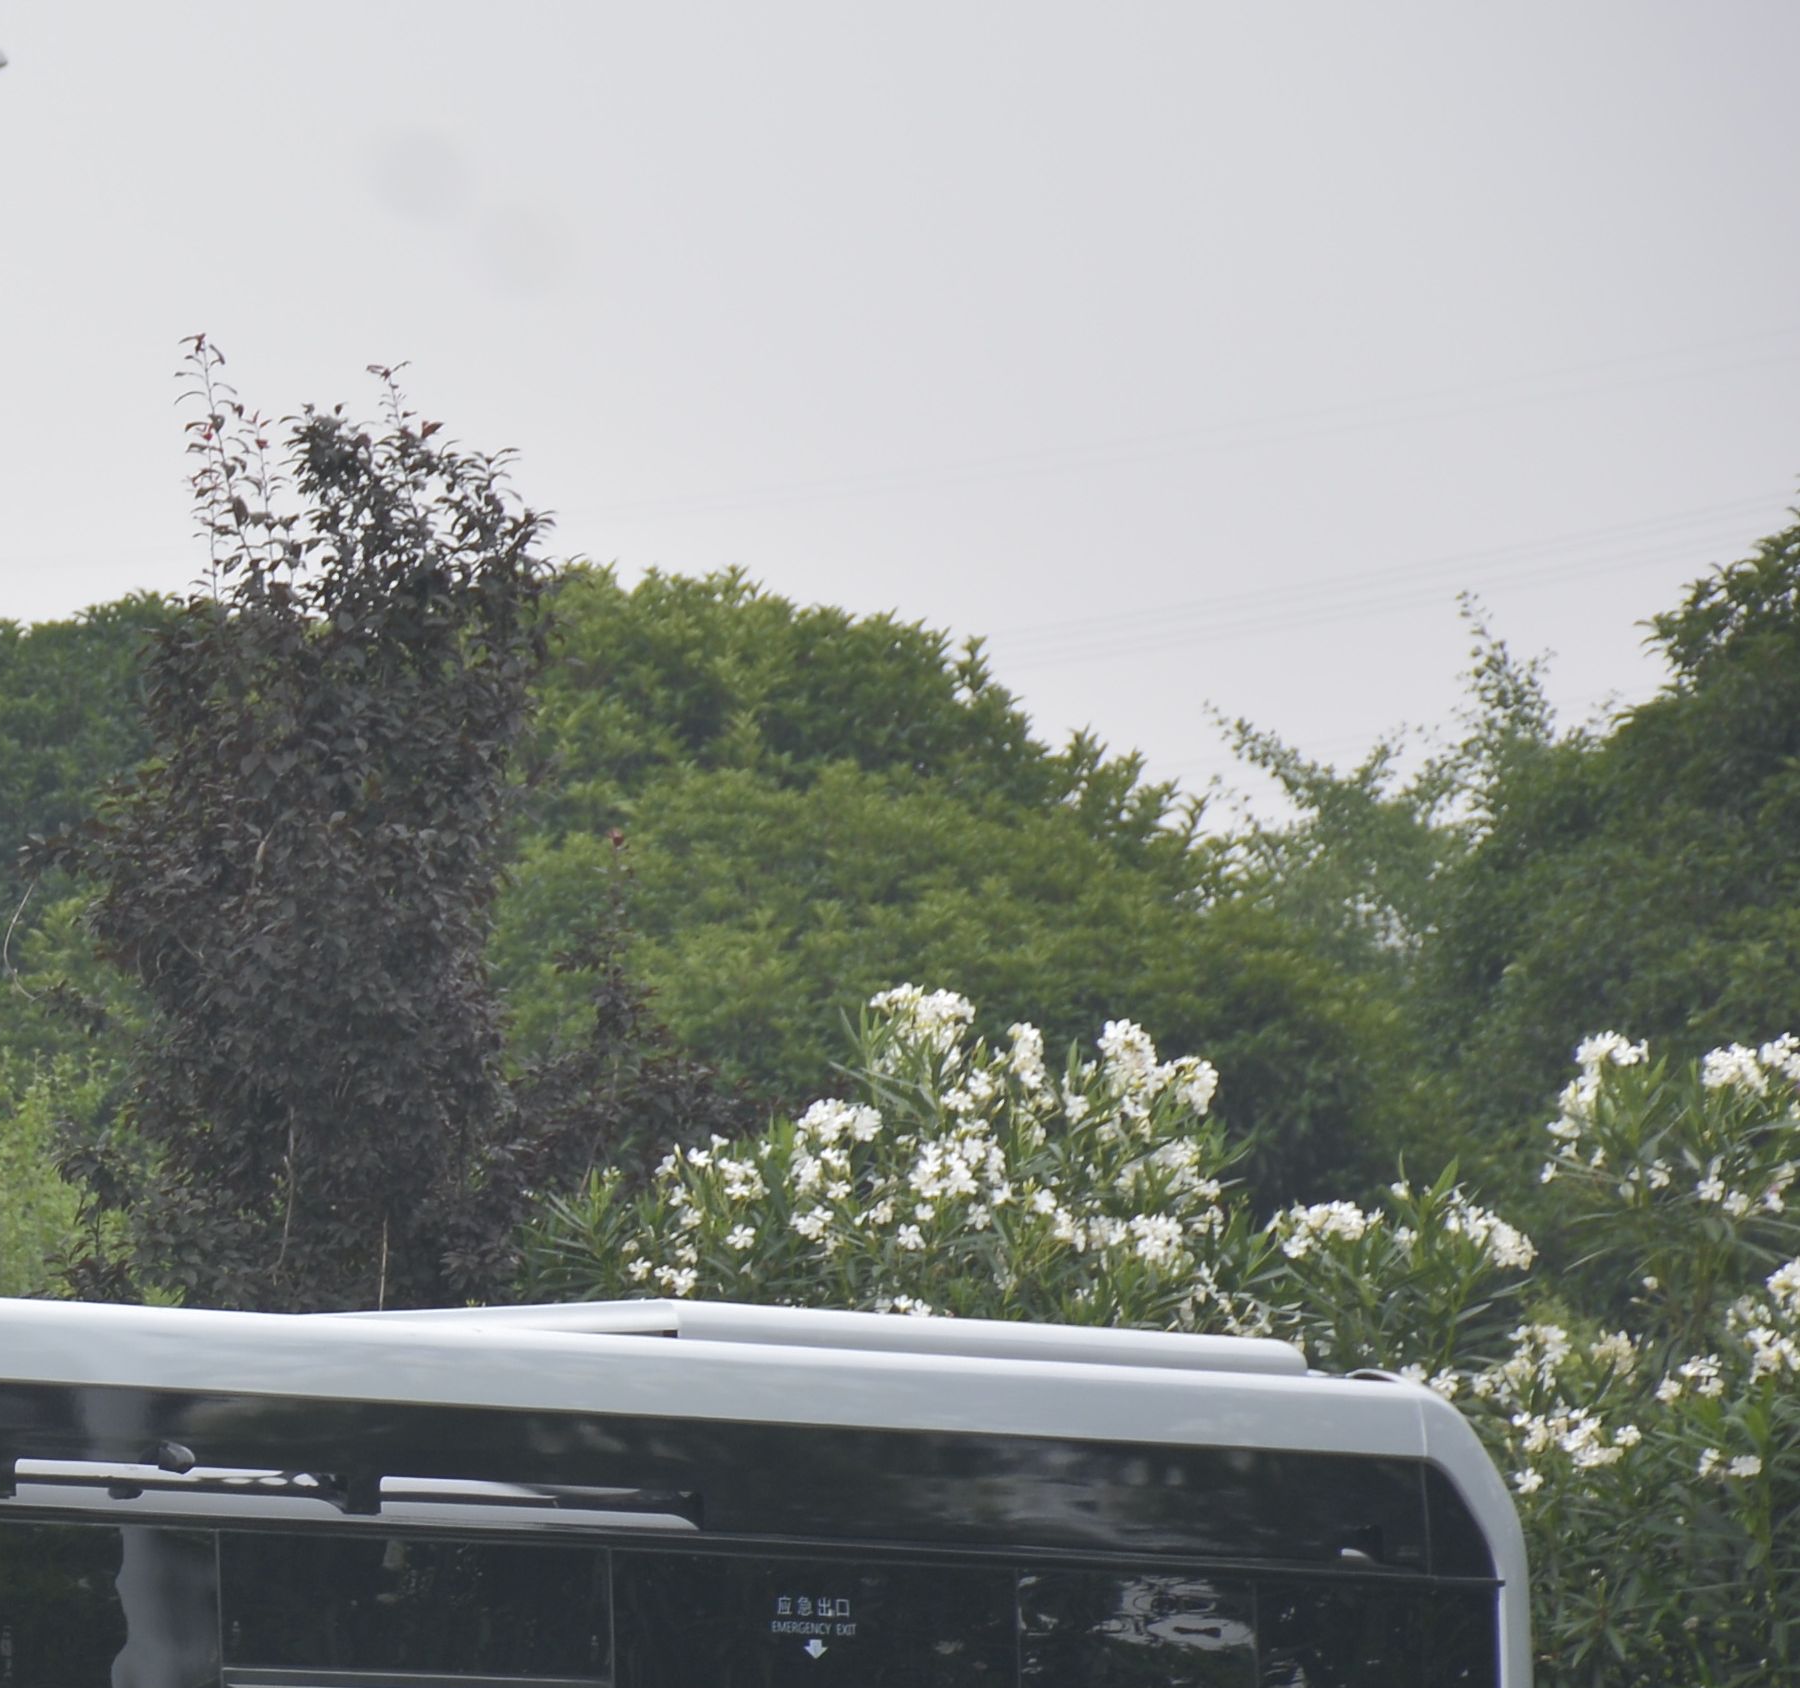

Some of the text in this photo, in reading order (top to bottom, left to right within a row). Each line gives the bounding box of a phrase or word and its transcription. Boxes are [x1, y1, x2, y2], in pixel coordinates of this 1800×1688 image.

[777, 1595, 850, 1617] 应急出口
[771, 1621, 856, 1635] EMERGENCY EXIT
